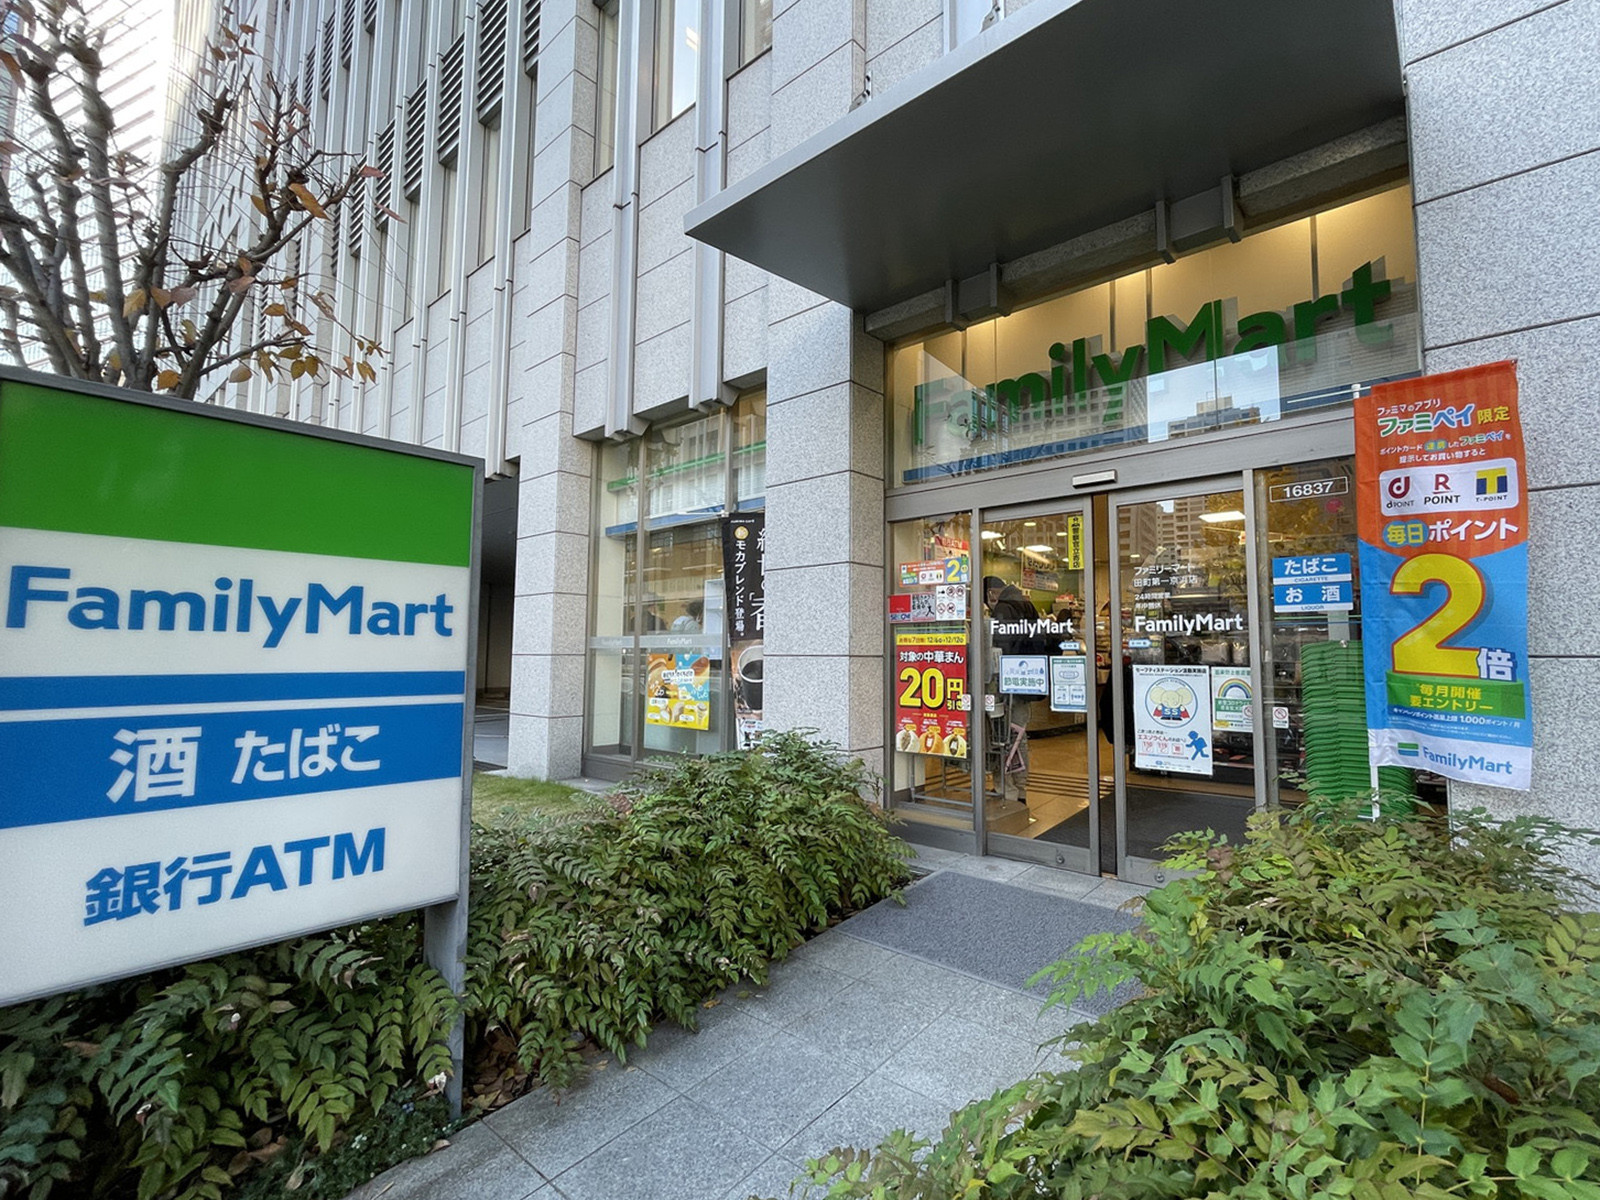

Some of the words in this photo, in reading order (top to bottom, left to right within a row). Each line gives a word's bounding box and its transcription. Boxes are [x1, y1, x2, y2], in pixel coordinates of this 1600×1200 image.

[913, 260, 1391, 445] FamilyMart
[1377, 398, 1441, 416] ファミマのアプリ
[1378, 403, 1476, 438] ファミペイ
[1477, 405, 1511, 425] 限定
[1399, 448, 1486, 464] 提示してお買い物すると
[1283, 481, 1334, 498] 16837
[1475, 494, 1508, 502] T-POINT
[1424, 494, 1461, 505] POINT
[1133, 563, 1195, 577] ファミリーマート
[1284, 556, 1338, 576] たばこ
[5, 564, 454, 649] FamilyMart
[991, 618, 1073, 638] FamilyMart
[1135, 613, 1243, 636] FamilyMart
[899, 650, 964, 664] 対象の中華まん
[1419, 683, 1482, 701] 毎月開催
[1164, 708, 1179, 716] SS
[1410, 695, 1494, 712] 要エントリー
[107, 725, 202, 803] 酒
[231, 723, 381, 784] たばこ
[1423, 747, 1513, 774] FamilyMart
[84, 827, 386, 927] 銀行ATM
